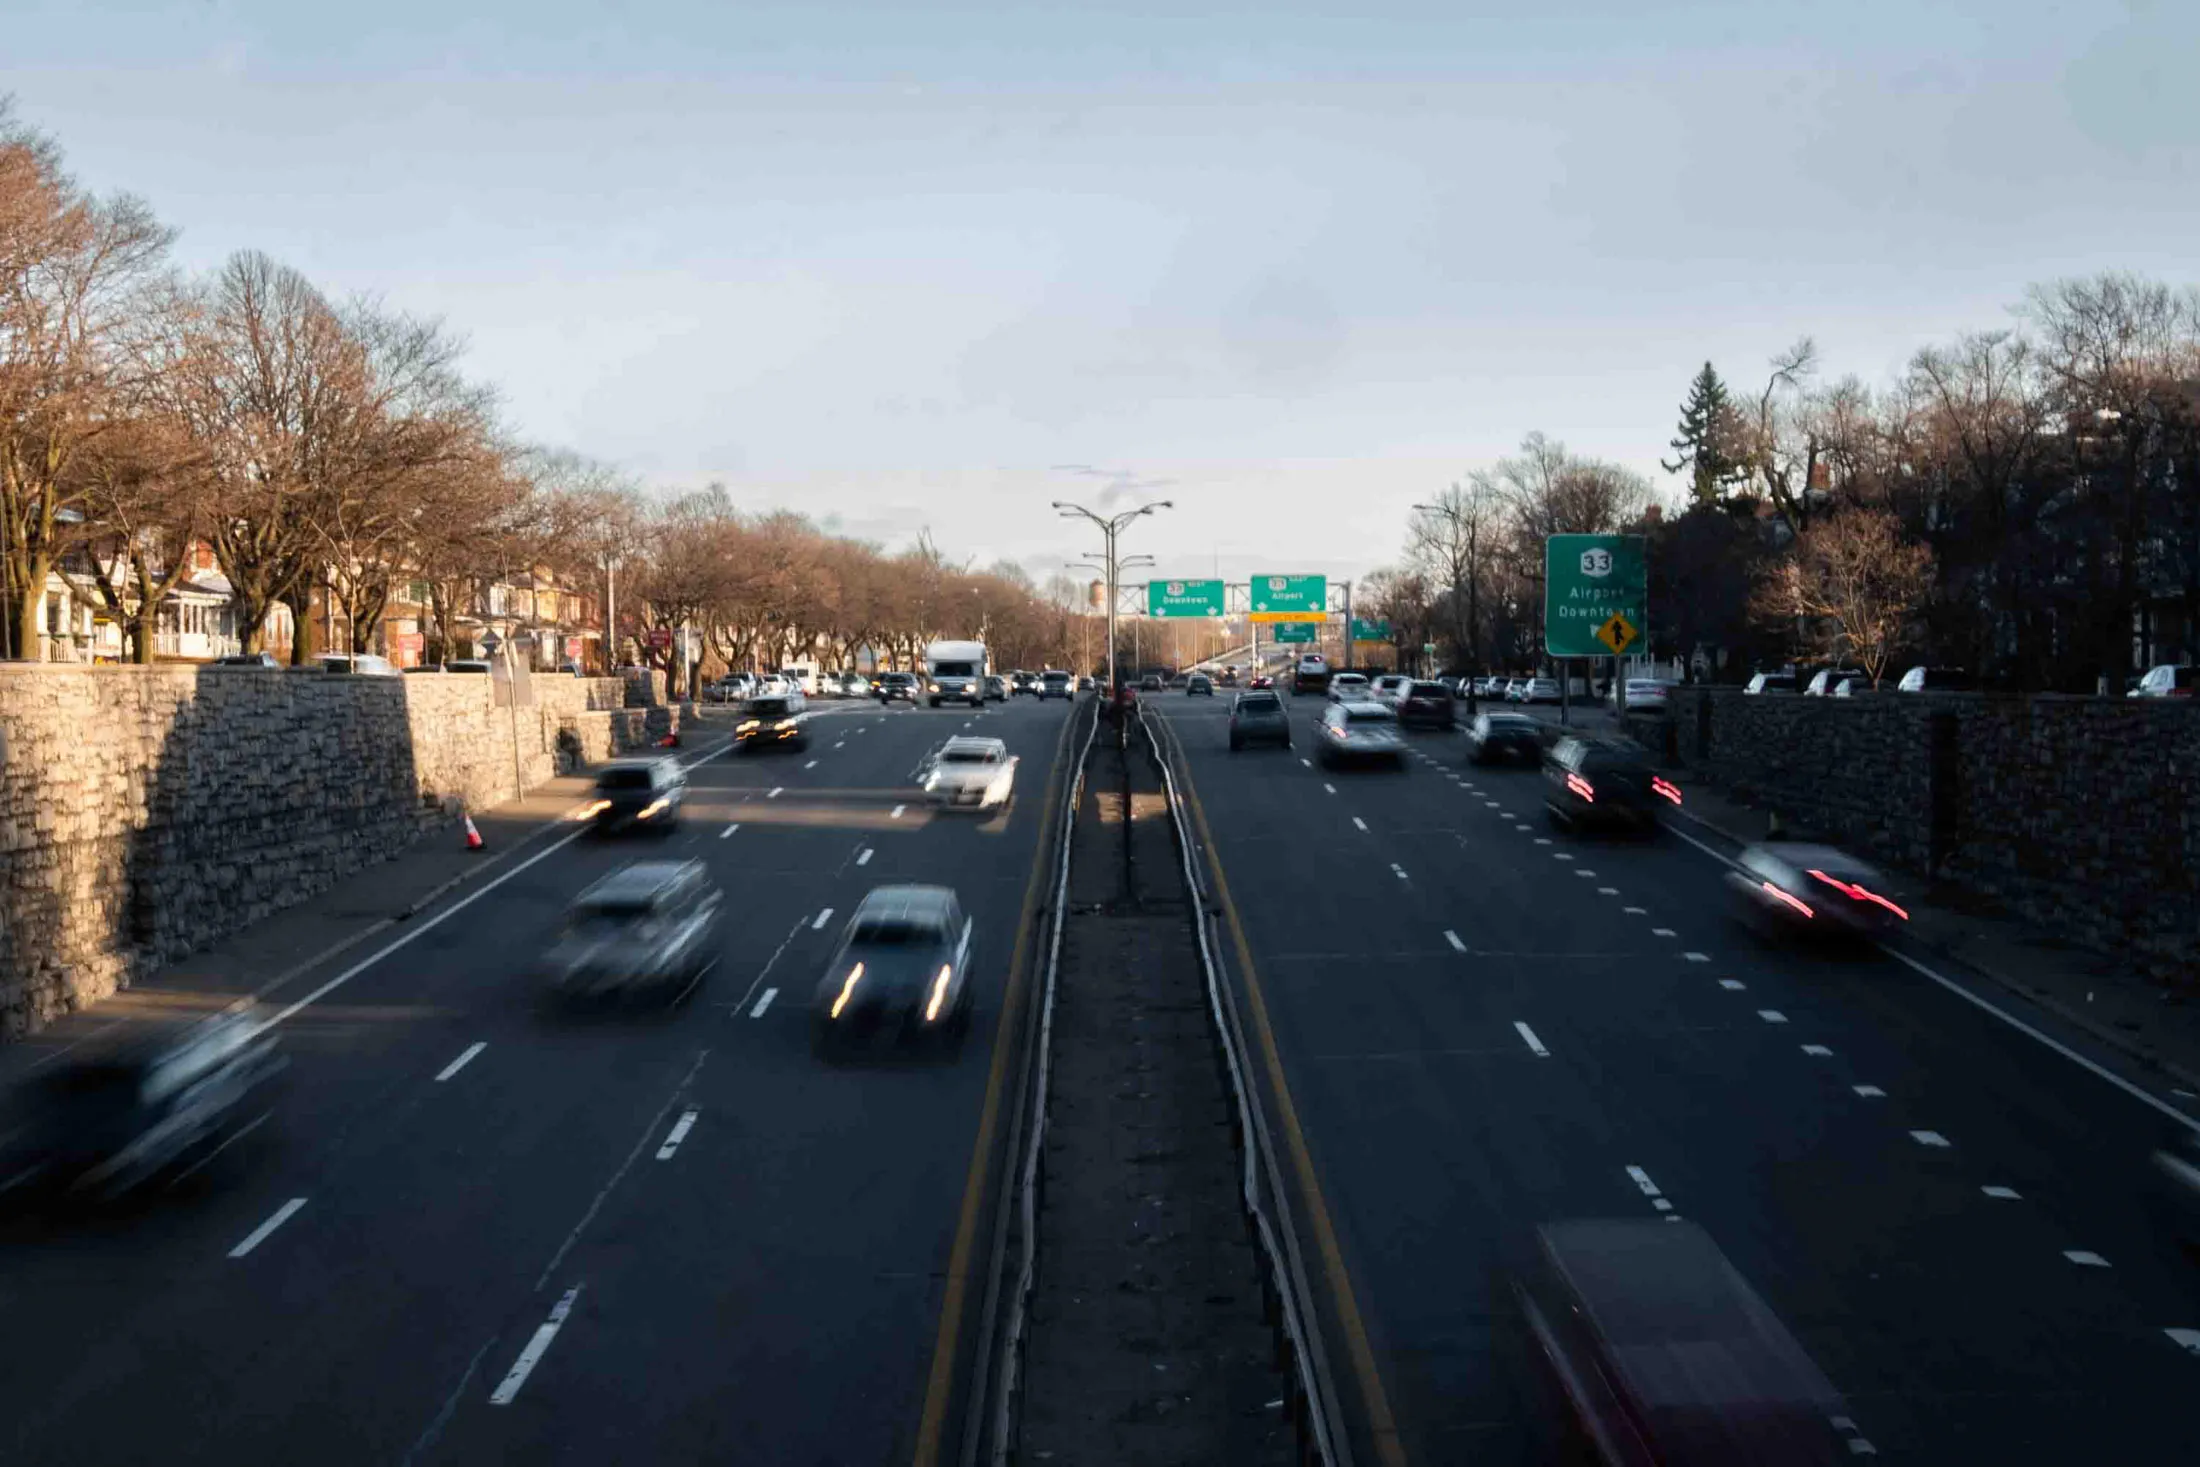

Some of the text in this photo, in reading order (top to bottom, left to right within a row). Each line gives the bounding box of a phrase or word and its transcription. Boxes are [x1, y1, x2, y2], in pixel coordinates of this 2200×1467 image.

[1584, 555, 1609, 570] 33
[1163, 595, 1208, 604] Downtown
[1569, 586, 1624, 602] Airport
